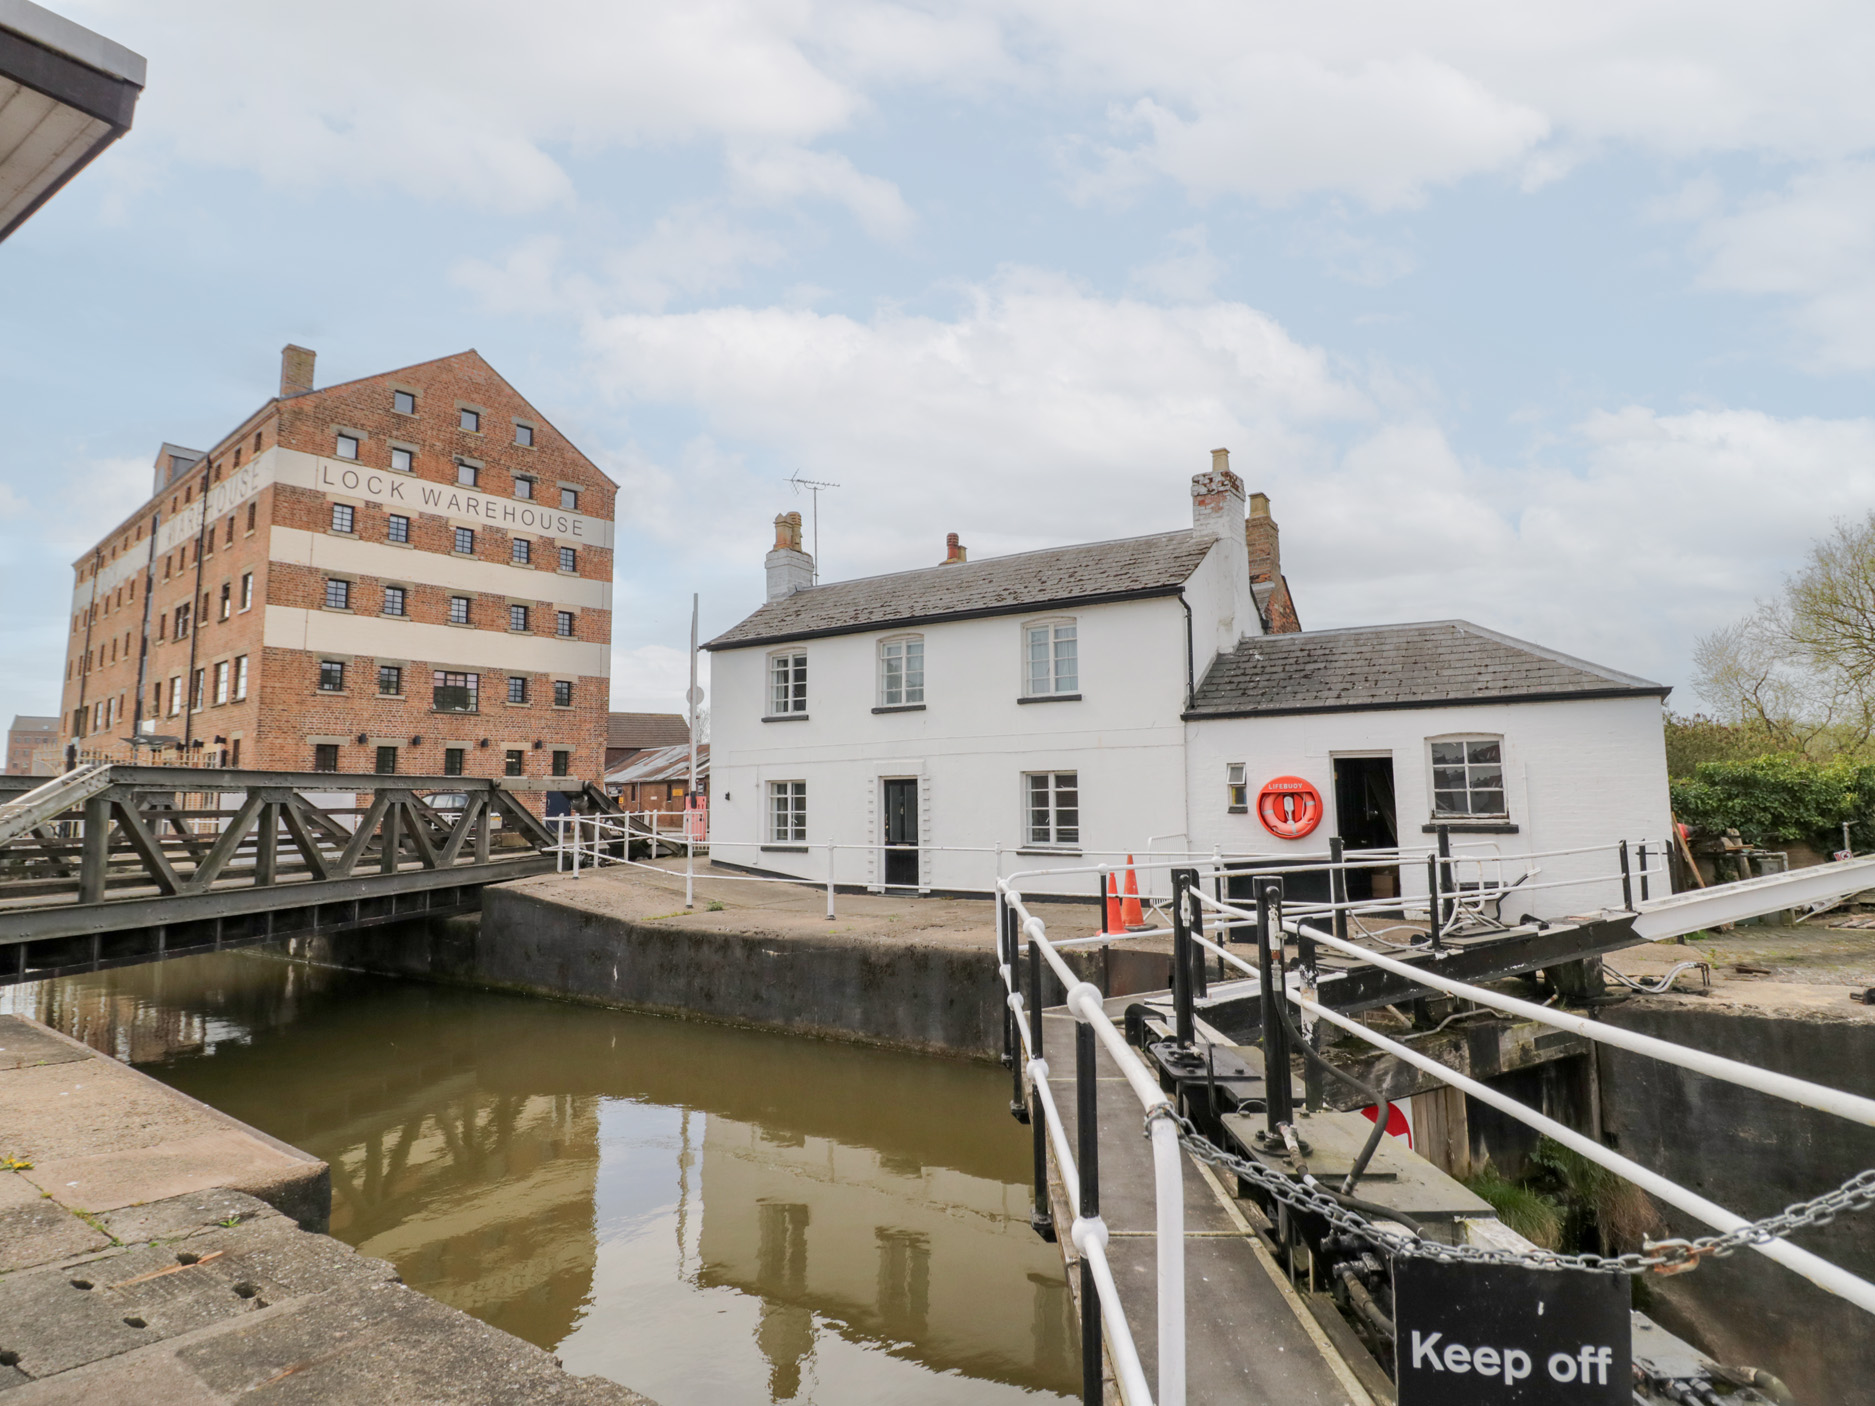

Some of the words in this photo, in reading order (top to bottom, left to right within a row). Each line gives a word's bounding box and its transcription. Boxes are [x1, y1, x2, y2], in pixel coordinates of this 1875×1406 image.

[322, 465, 405, 501] LOCK
[422, 487, 583, 537] WAREHOUSE
[1411, 1330, 1532, 1386] Keep
[1547, 1345, 1612, 1385] off
